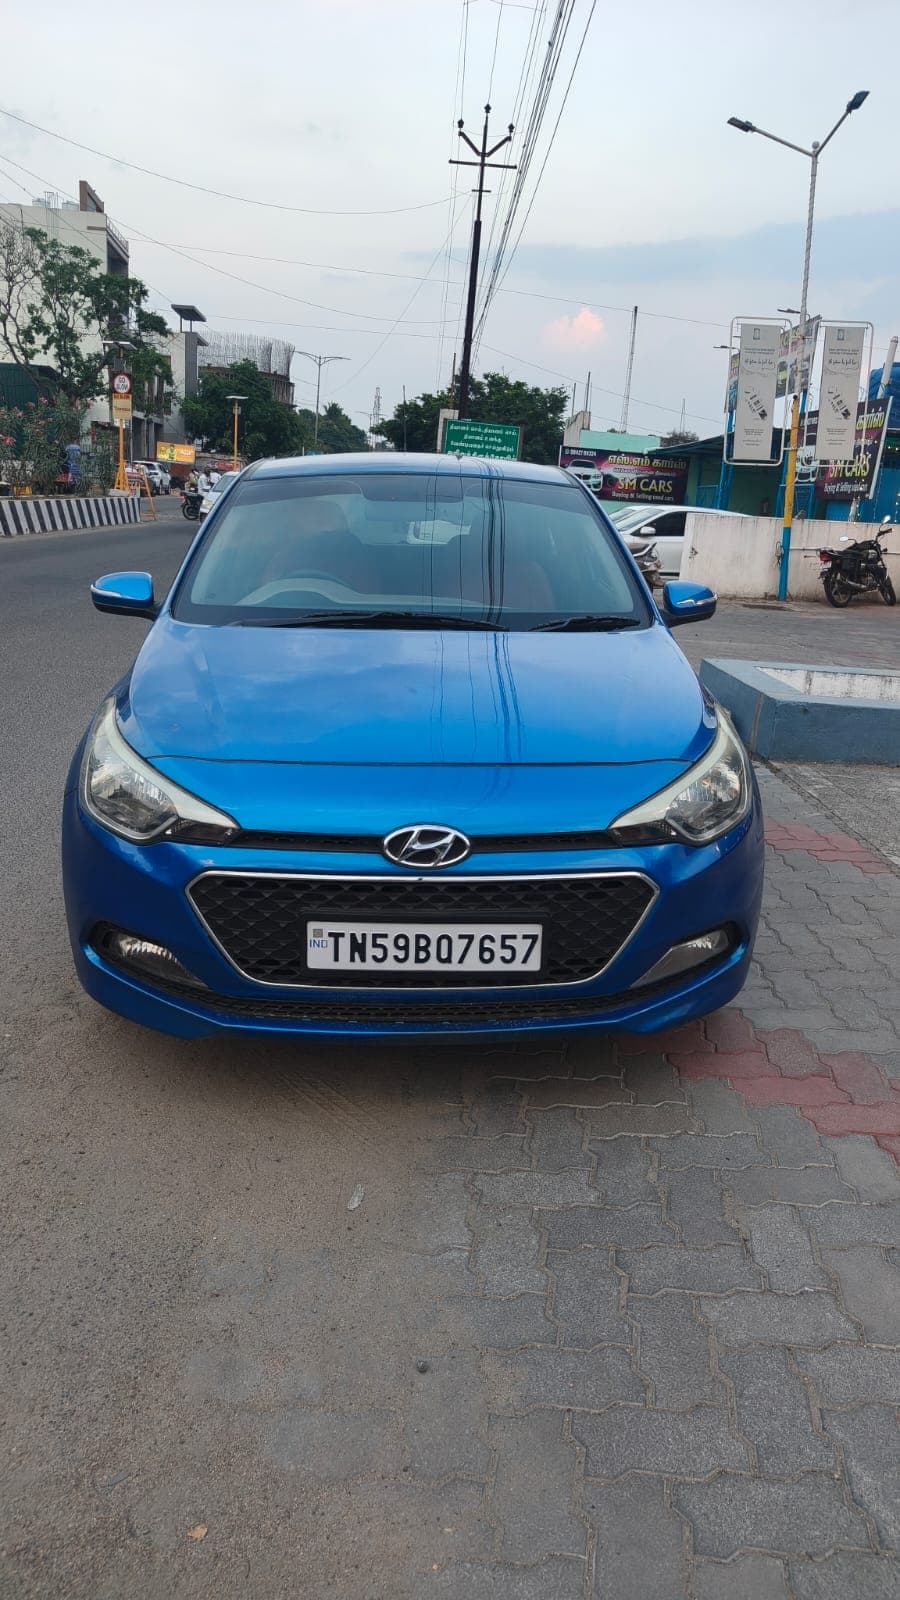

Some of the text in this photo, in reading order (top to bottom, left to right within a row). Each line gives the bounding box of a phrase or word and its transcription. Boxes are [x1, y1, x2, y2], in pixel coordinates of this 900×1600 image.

[845, 453, 872, 477] CARS
[618, 477, 673, 493] SM CARS
[636, 493, 653, 501] Selling
[309, 932, 539, 964] IND TN59BQ7657
